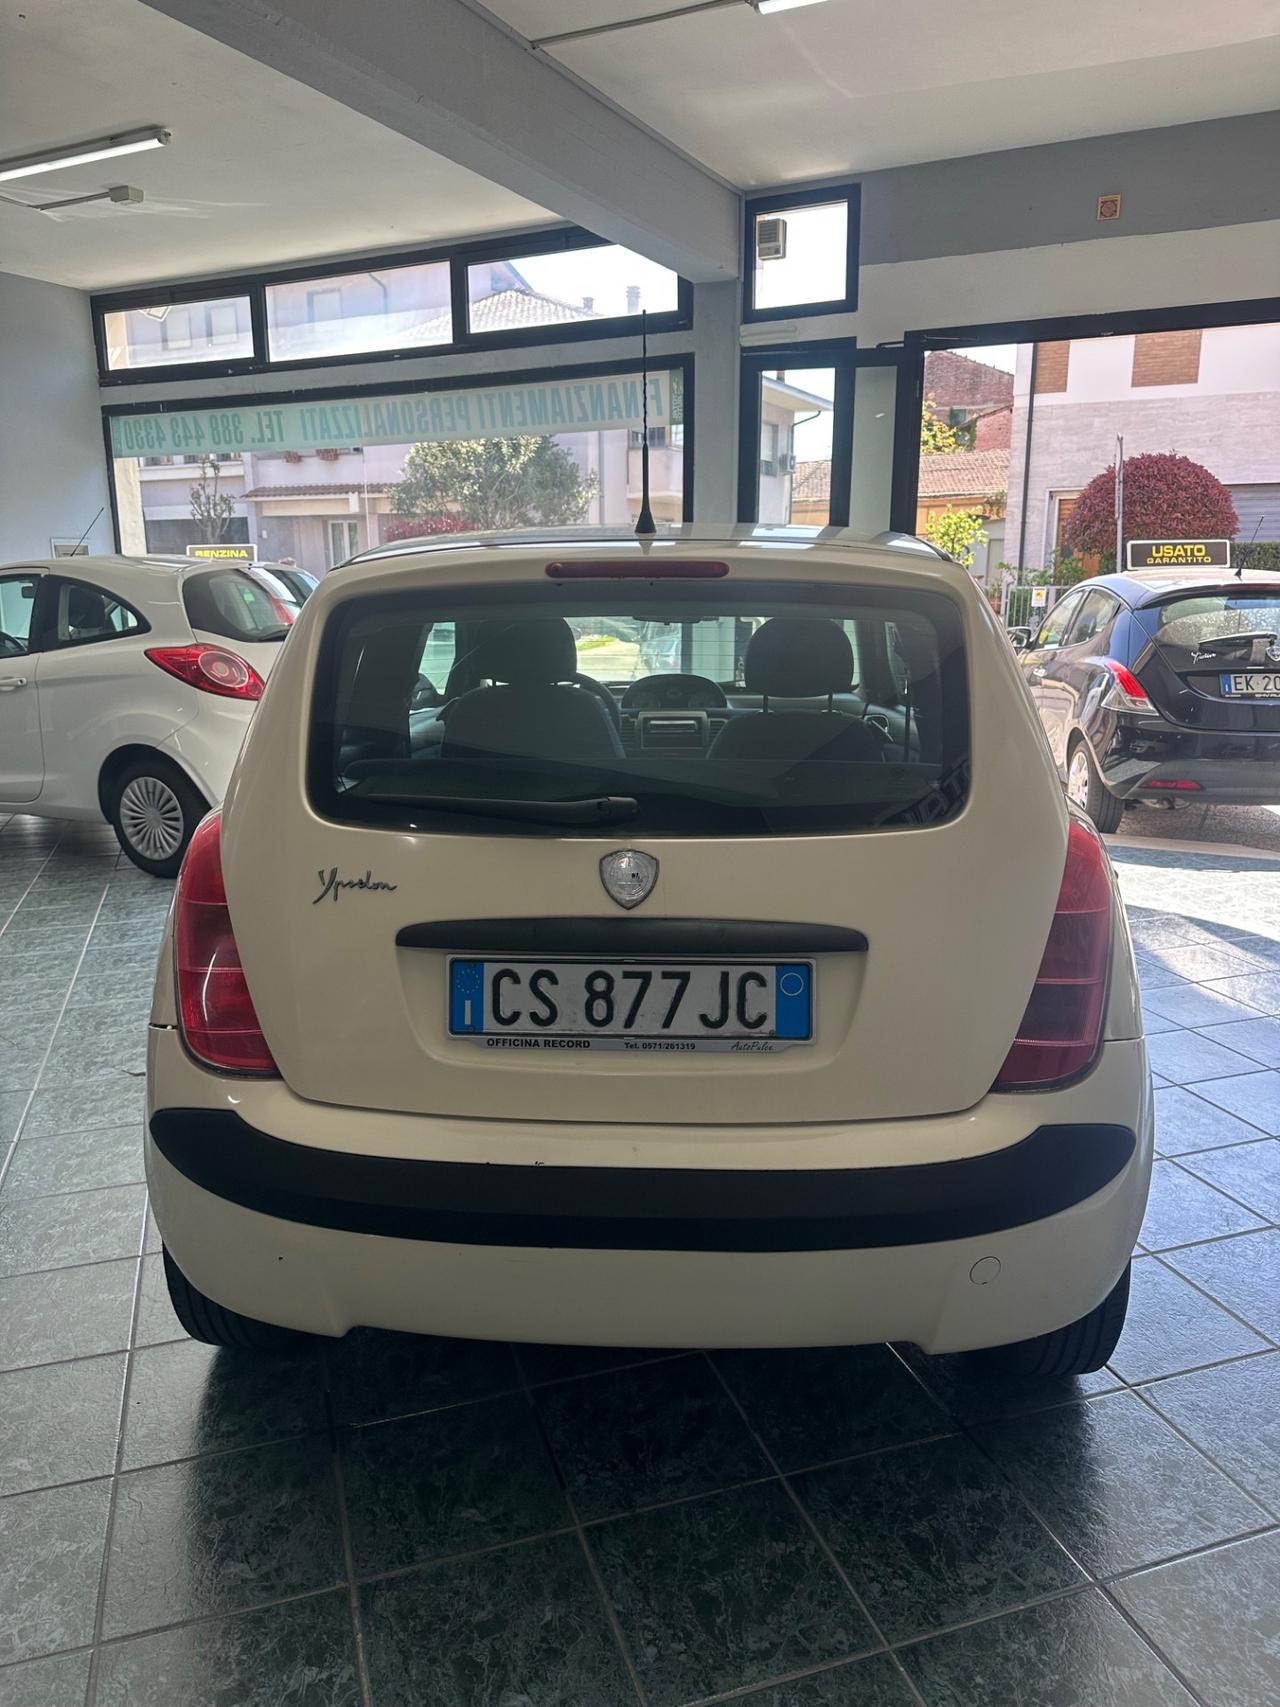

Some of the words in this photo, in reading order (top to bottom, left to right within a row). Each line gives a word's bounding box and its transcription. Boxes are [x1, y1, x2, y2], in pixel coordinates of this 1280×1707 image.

[194, 549, 248, 558] BENZINA
[1152, 544, 1206, 557] USATO
[1146, 556, 1212, 565] GARANTITO
[1233, 675, 1255, 691] EK
[491, 968, 560, 1027] CS
[584, 969, 691, 1029] 877
[699, 971, 768, 1029] JC
[486, 1038, 540, 1048] OFFICINA
[543, 1039, 591, 1048] RECORD
